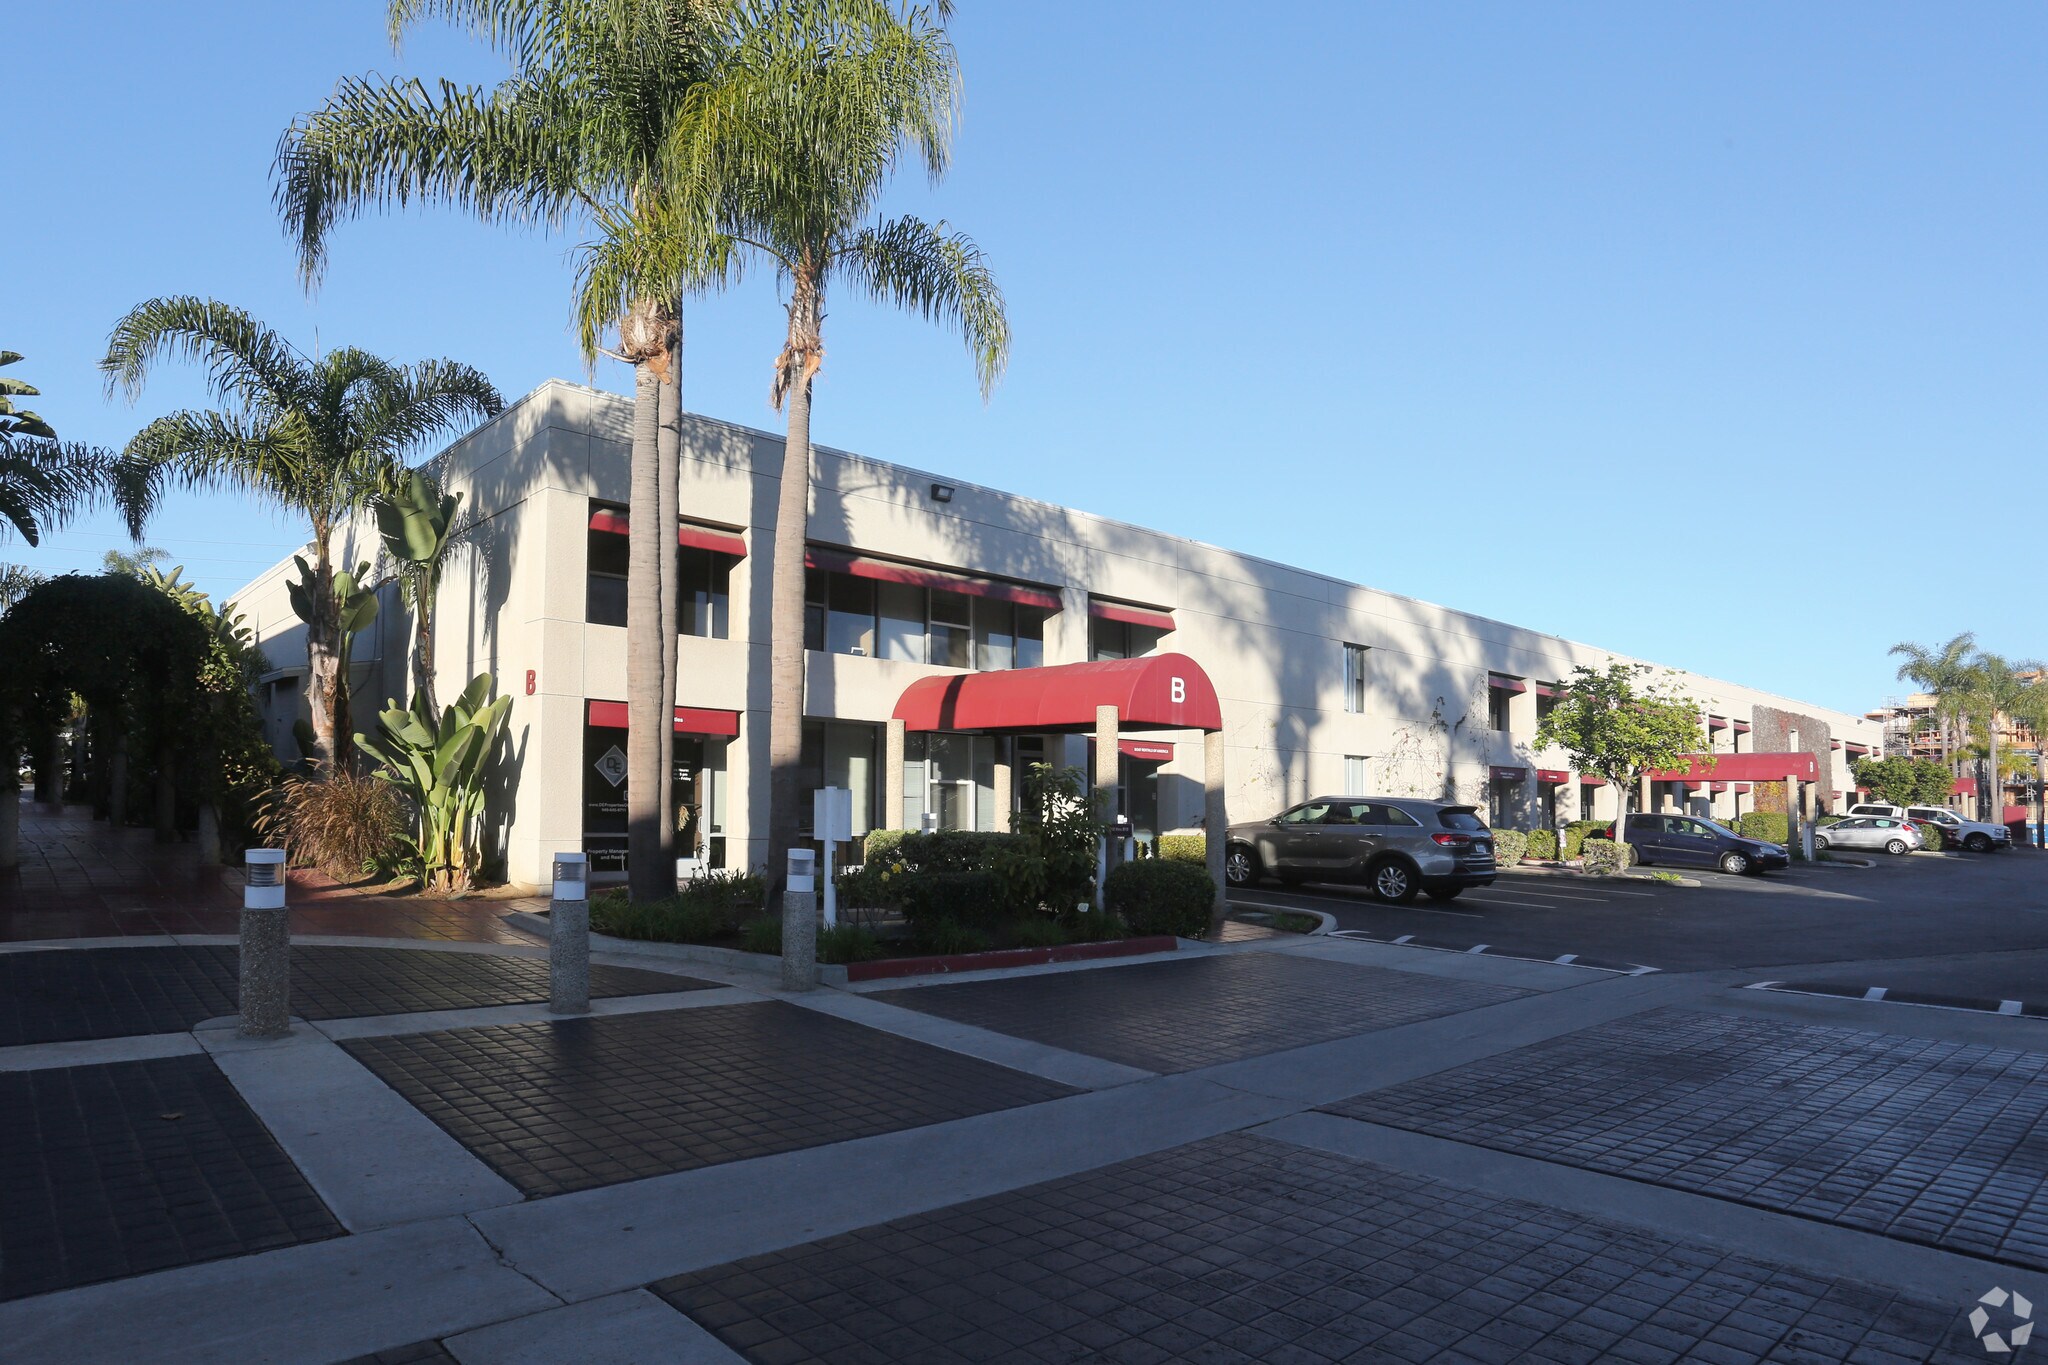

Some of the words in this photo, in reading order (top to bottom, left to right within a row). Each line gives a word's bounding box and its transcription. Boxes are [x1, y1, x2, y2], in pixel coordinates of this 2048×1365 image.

[526, 669, 536, 695] B
[1171, 676, 1186, 703] B
[606, 757, 622, 774] DE
